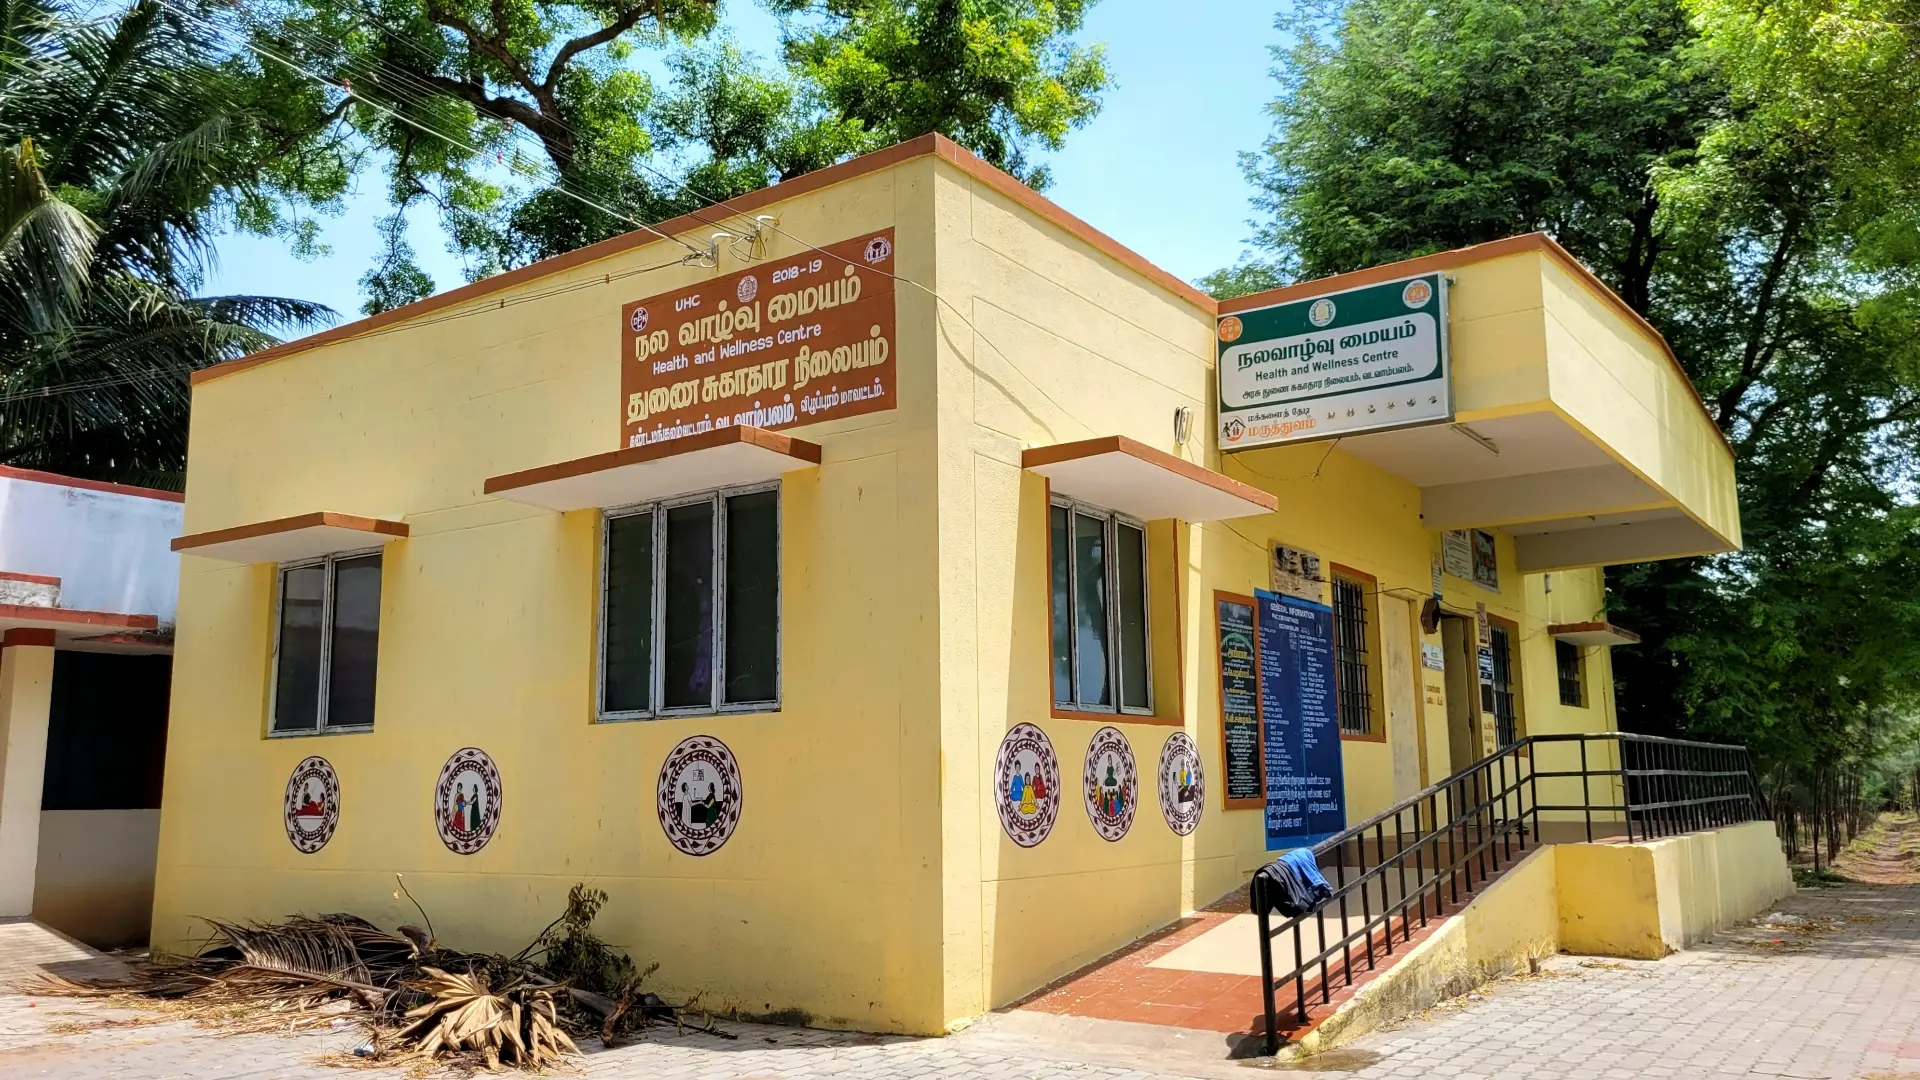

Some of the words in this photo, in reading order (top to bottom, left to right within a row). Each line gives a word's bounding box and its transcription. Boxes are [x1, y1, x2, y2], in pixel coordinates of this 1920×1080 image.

[635, 328, 668, 362] நல
[679, 300, 760, 343] வாழ்வு
[767, 265, 861, 323] மையம்
[676, 294, 701, 312] UHC
[653, 355, 688, 375] Health
[694, 348, 715, 366] and
[720, 335, 773, 360] Wellness
[778, 324, 822, 345] Centre
[1238, 336, 1334, 371] நலவாழ்வு
[1339, 320, 1417, 349] மையம்
[1255, 365, 1288, 381] Health
[1291, 362, 1310, 376] and
[1312, 356, 1359, 372] Wellness
[1362, 350, 1399, 364] Centre
[627, 379, 699, 425] துணை
[702, 359, 789, 403] சுகாதார
[793, 324, 889, 390] நிலையம்
[1242, 389, 1261, 400] அரசு
[1262, 385, 1289, 398] துணை
[1290, 380, 1323, 394] சுகாதார
[1248, 415, 1316, 437] மருத்துவம்
